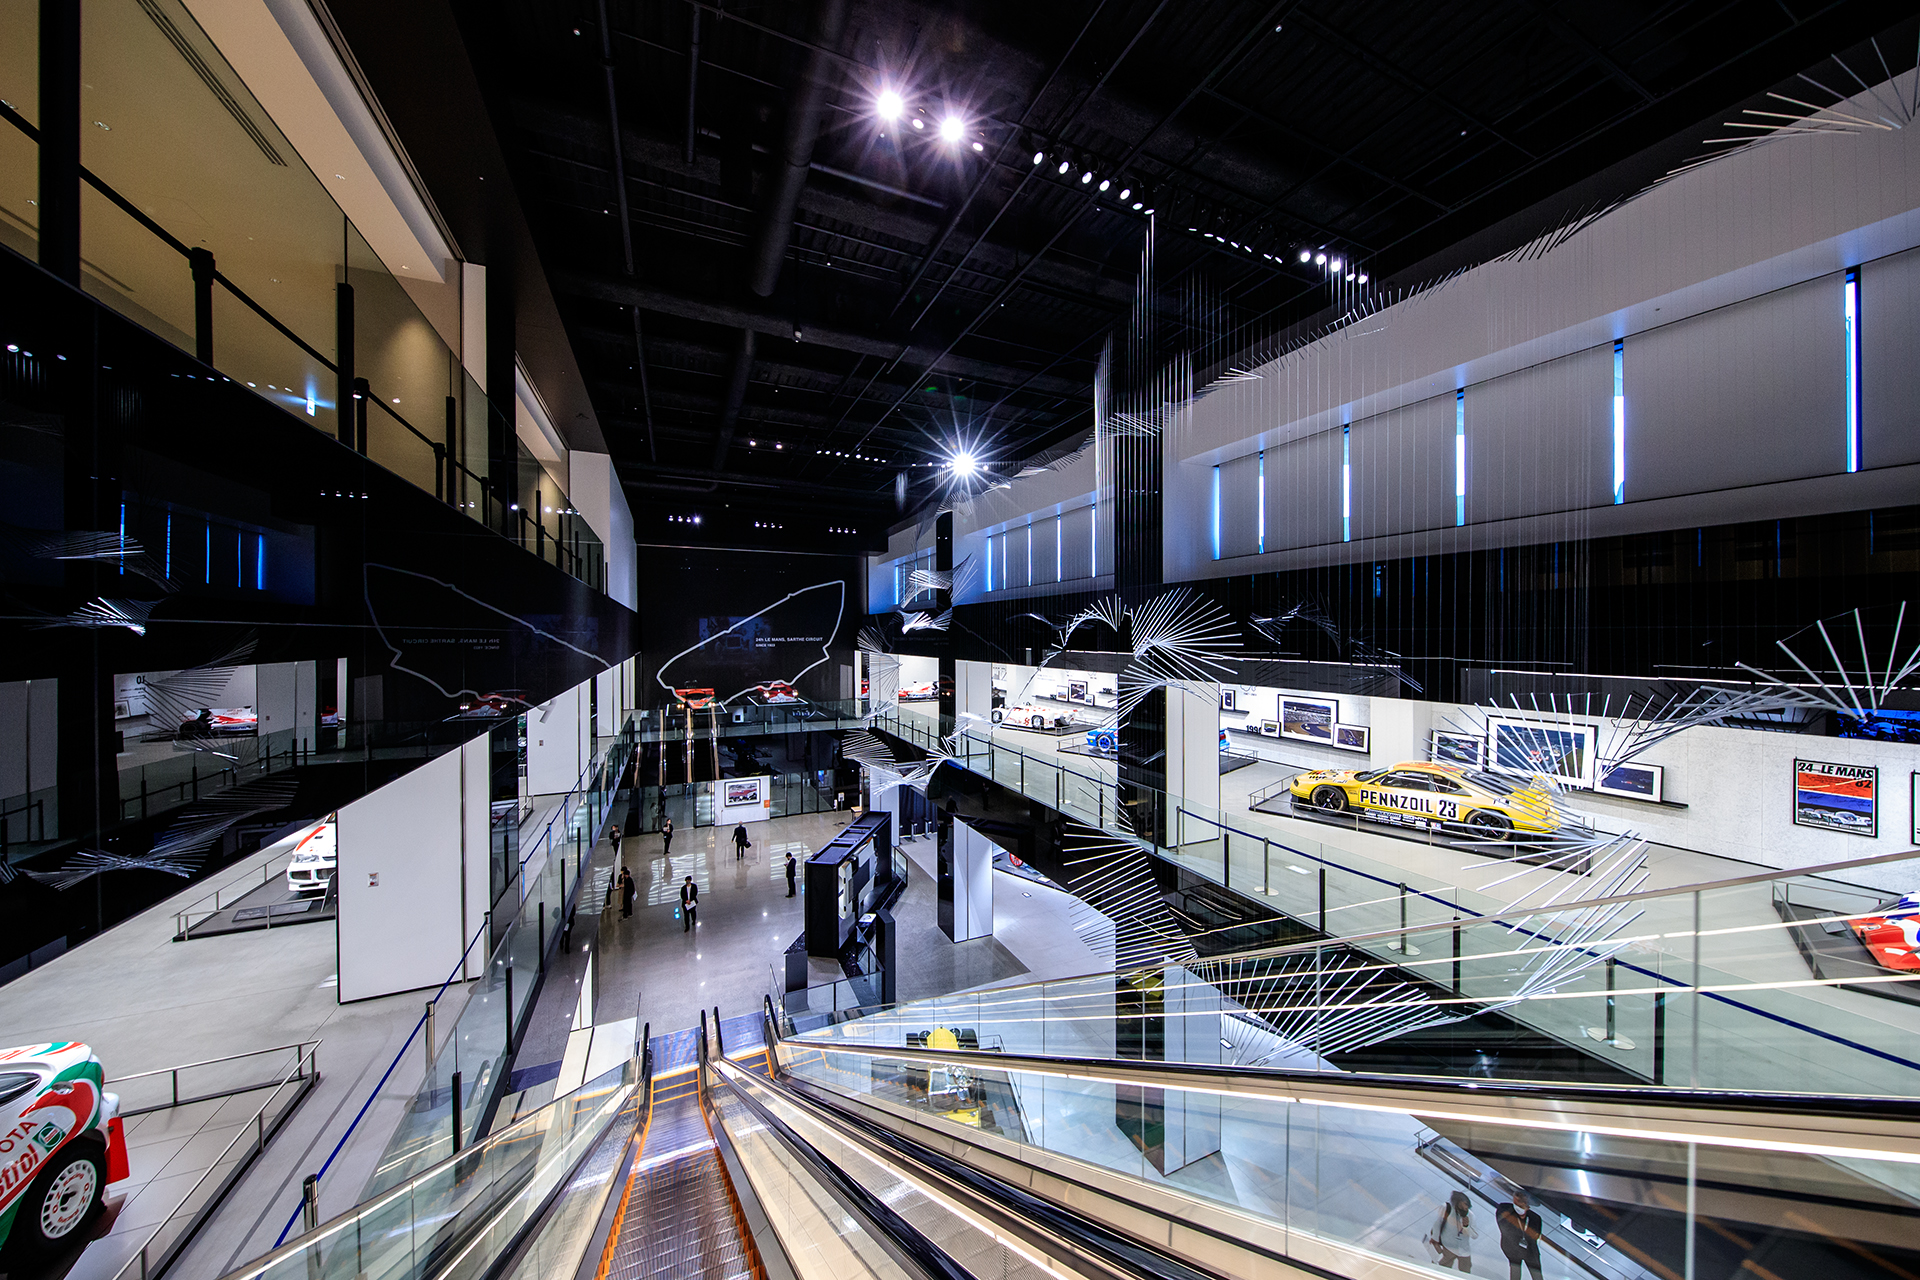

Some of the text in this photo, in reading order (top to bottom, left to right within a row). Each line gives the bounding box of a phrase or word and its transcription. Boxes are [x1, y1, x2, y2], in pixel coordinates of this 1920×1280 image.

[1821, 764, 1835, 775] LE
[1835, 766, 1873, 778] MANS
[1360, 789, 1433, 813] PENNZOIL
[1438, 800, 1456, 818] 23
